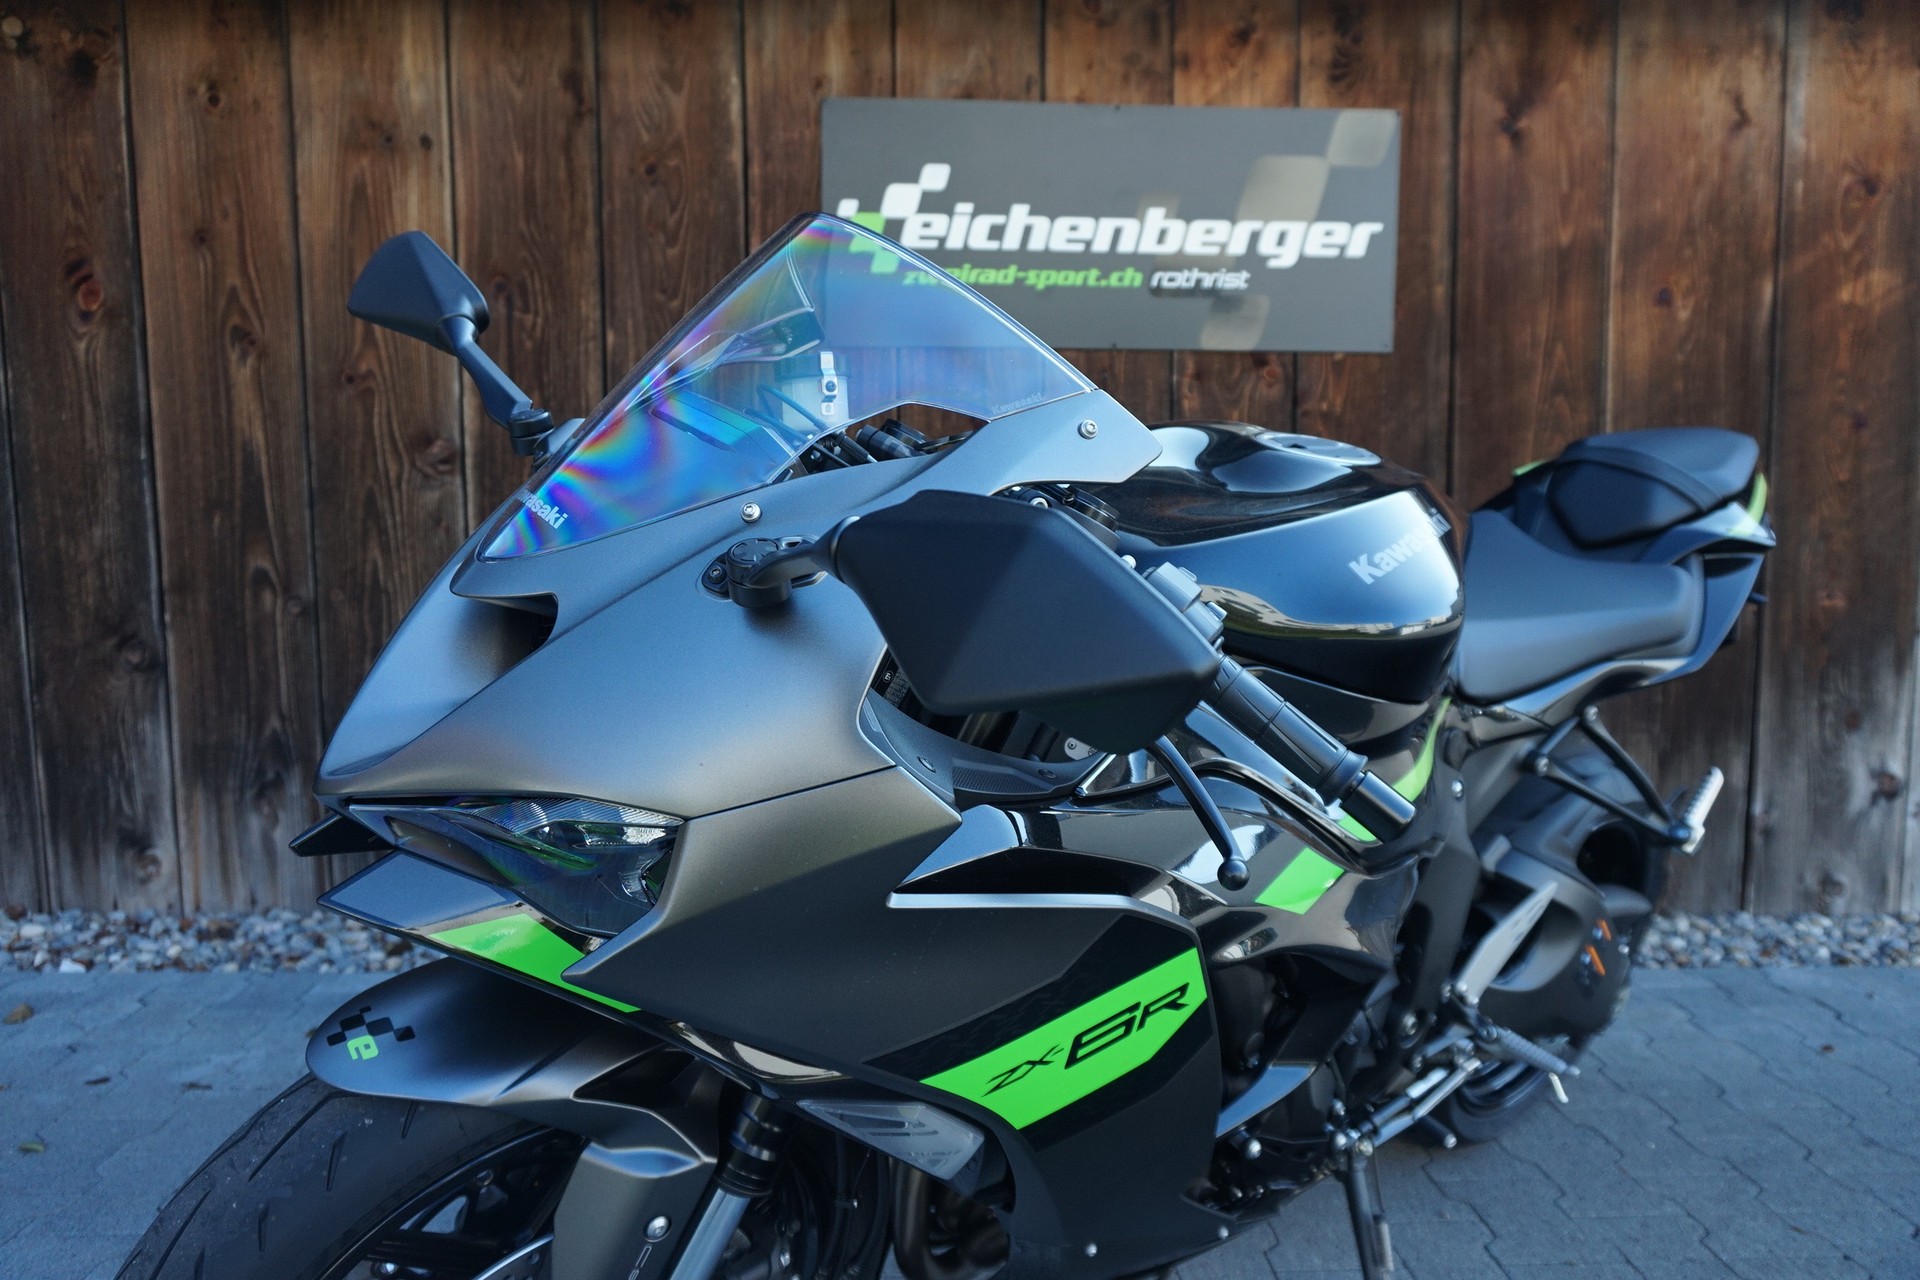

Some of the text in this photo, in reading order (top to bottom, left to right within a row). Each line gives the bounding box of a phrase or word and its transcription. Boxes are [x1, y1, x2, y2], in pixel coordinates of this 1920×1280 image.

[901, 203, 1383, 268] eichenberger
[1149, 267, 1251, 290] rothrist
[981, 982, 1190, 1098] ZX-6R
